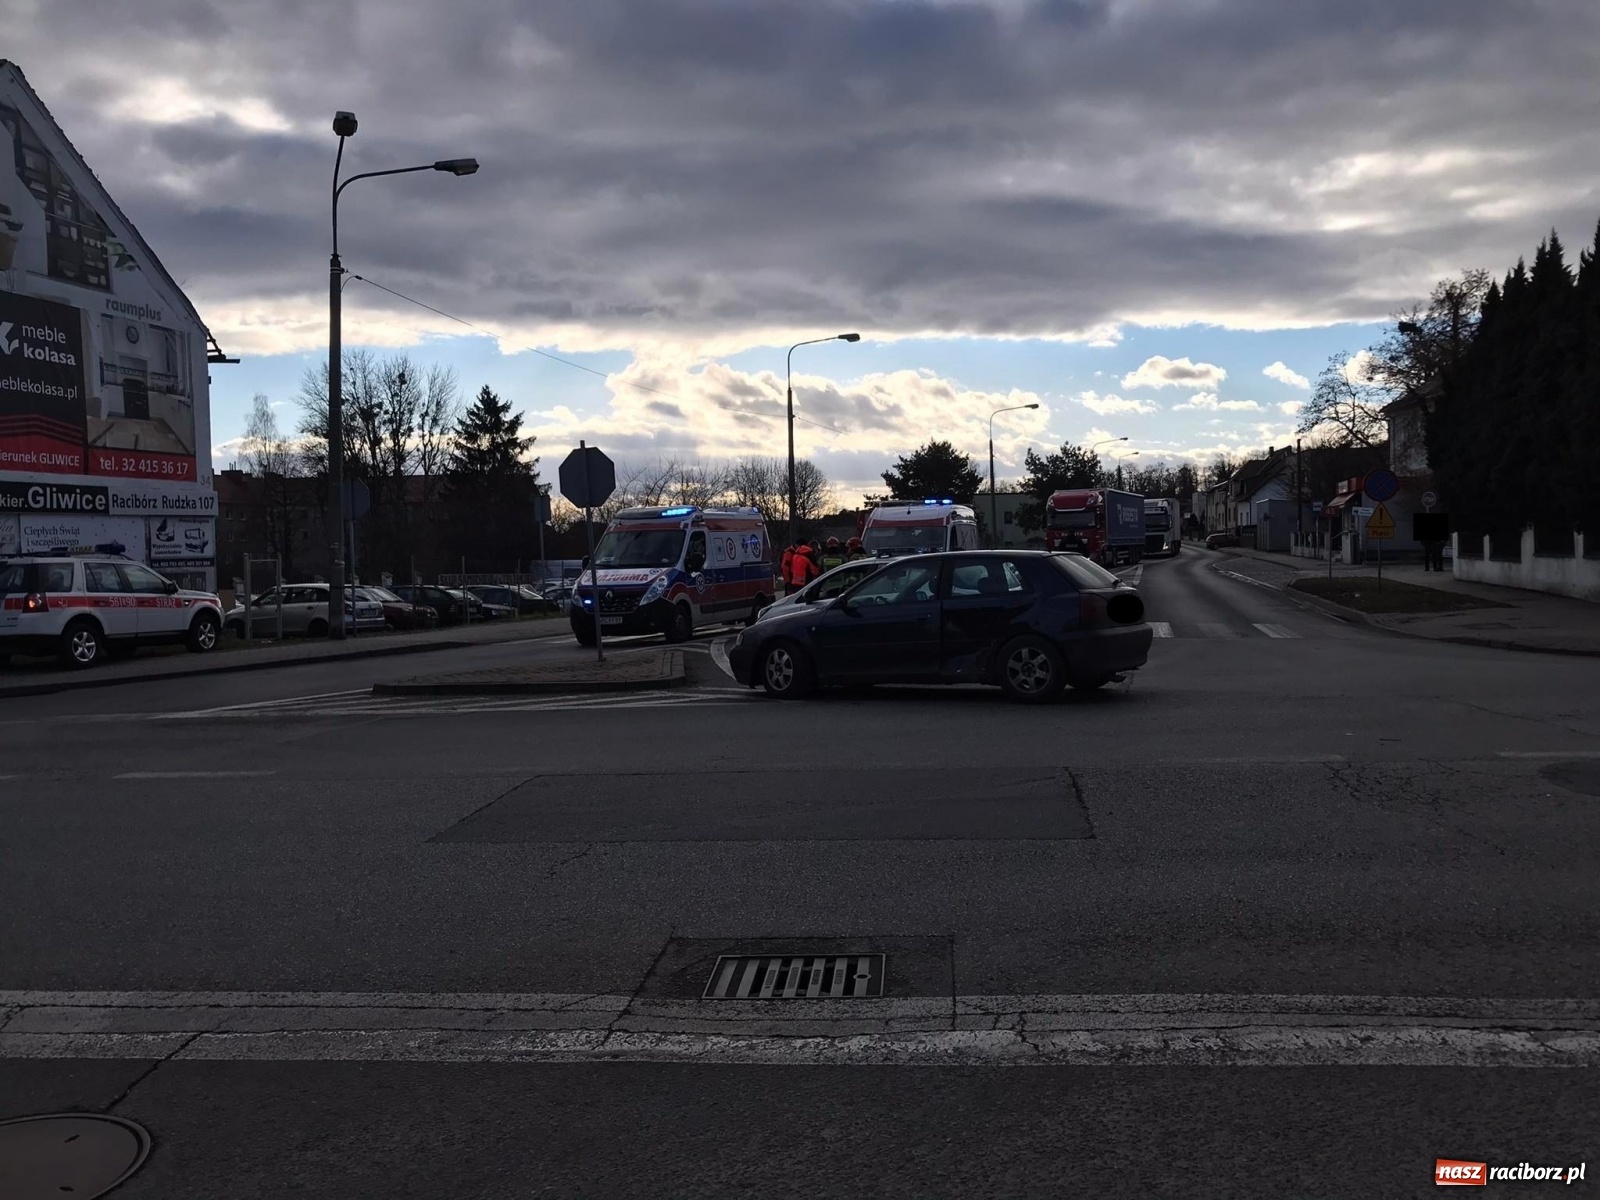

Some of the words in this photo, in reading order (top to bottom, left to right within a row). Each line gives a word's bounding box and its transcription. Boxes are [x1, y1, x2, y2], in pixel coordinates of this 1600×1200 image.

[105, 299, 162, 321] raumplus
[22, 325, 66, 344] meble
[23, 342, 76, 366] kolasa
[40, 452, 80, 467] GLIWICE
[100, 456, 119, 470] tel.
[122, 458, 136, 472] 32
[138, 459, 158, 473] 415
[161, 461, 174, 474] 36
[177, 462, 188, 475] 17
[112, 494, 158, 509] Racibórz
[162, 495, 196, 509] Rudzka
[199, 497, 214, 510] 107
[24, 526, 58, 538] Ciepłych
[60, 525, 80, 538] Świąt
